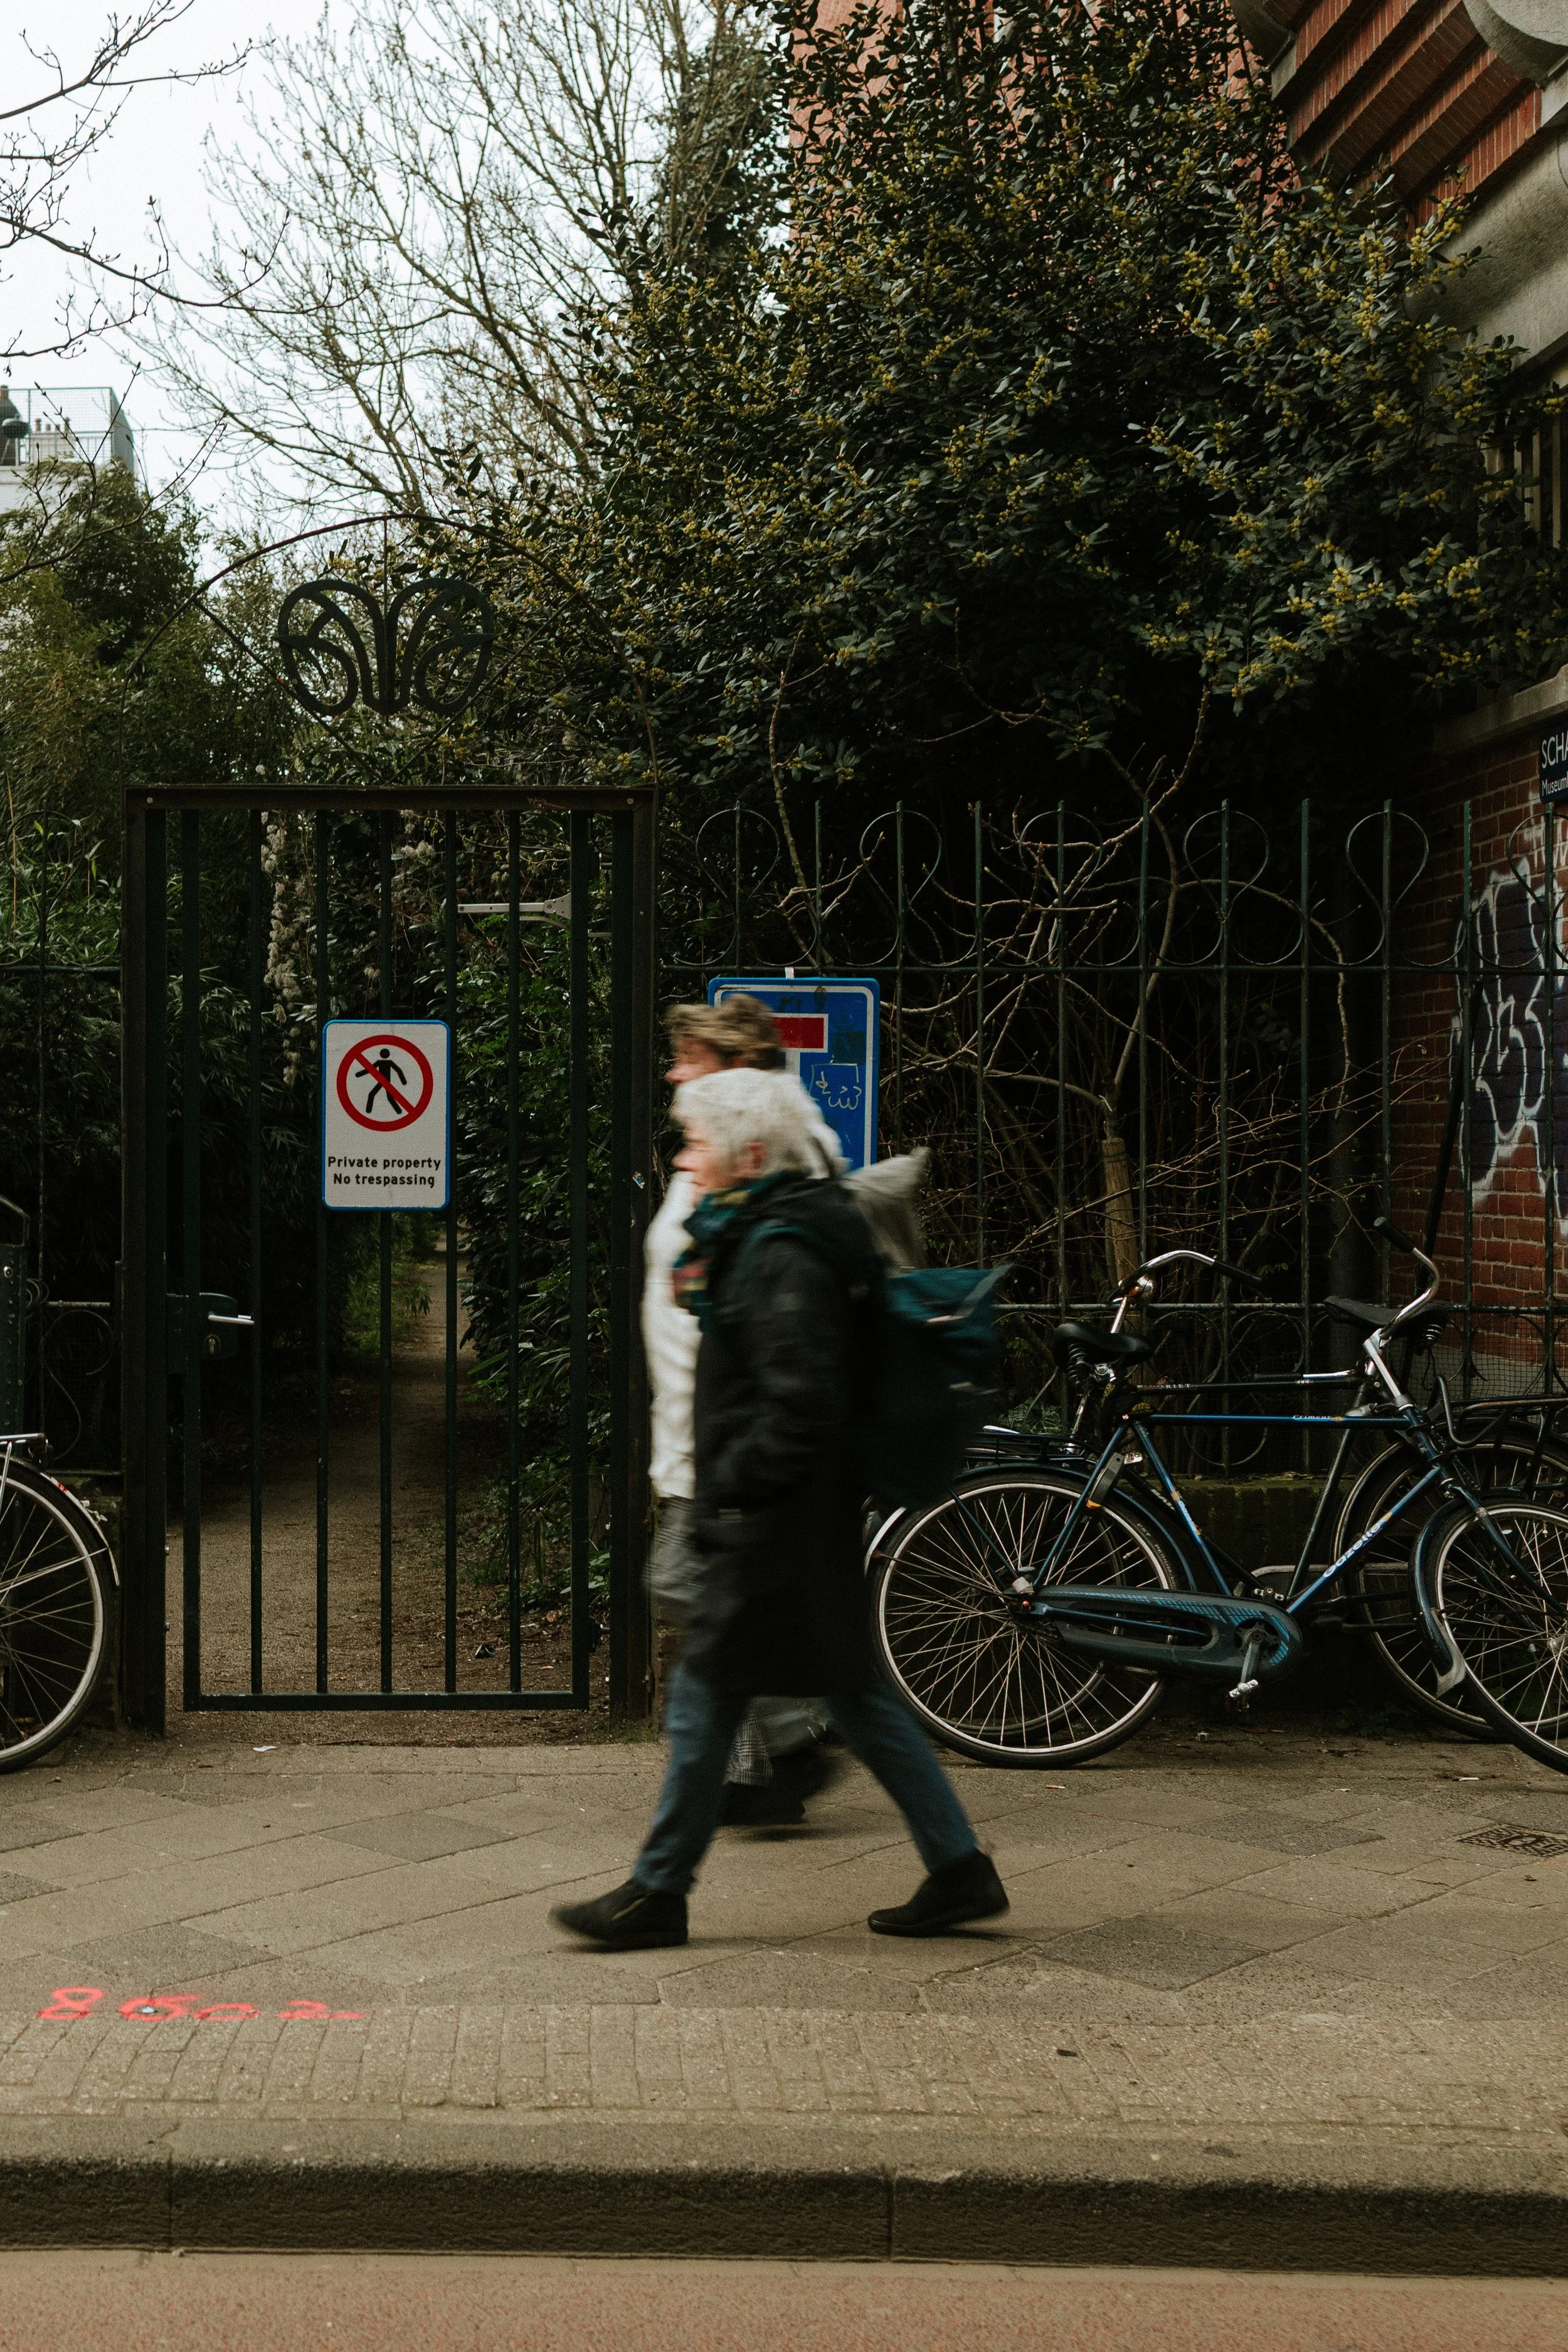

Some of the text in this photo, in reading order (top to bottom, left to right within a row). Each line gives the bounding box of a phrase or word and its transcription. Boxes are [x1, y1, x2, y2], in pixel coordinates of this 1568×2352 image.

[327, 1156, 441, 1170] Private property
[333, 1173, 435, 1189] No trespassing
[1323, 1522, 1382, 1578] Gazelle
